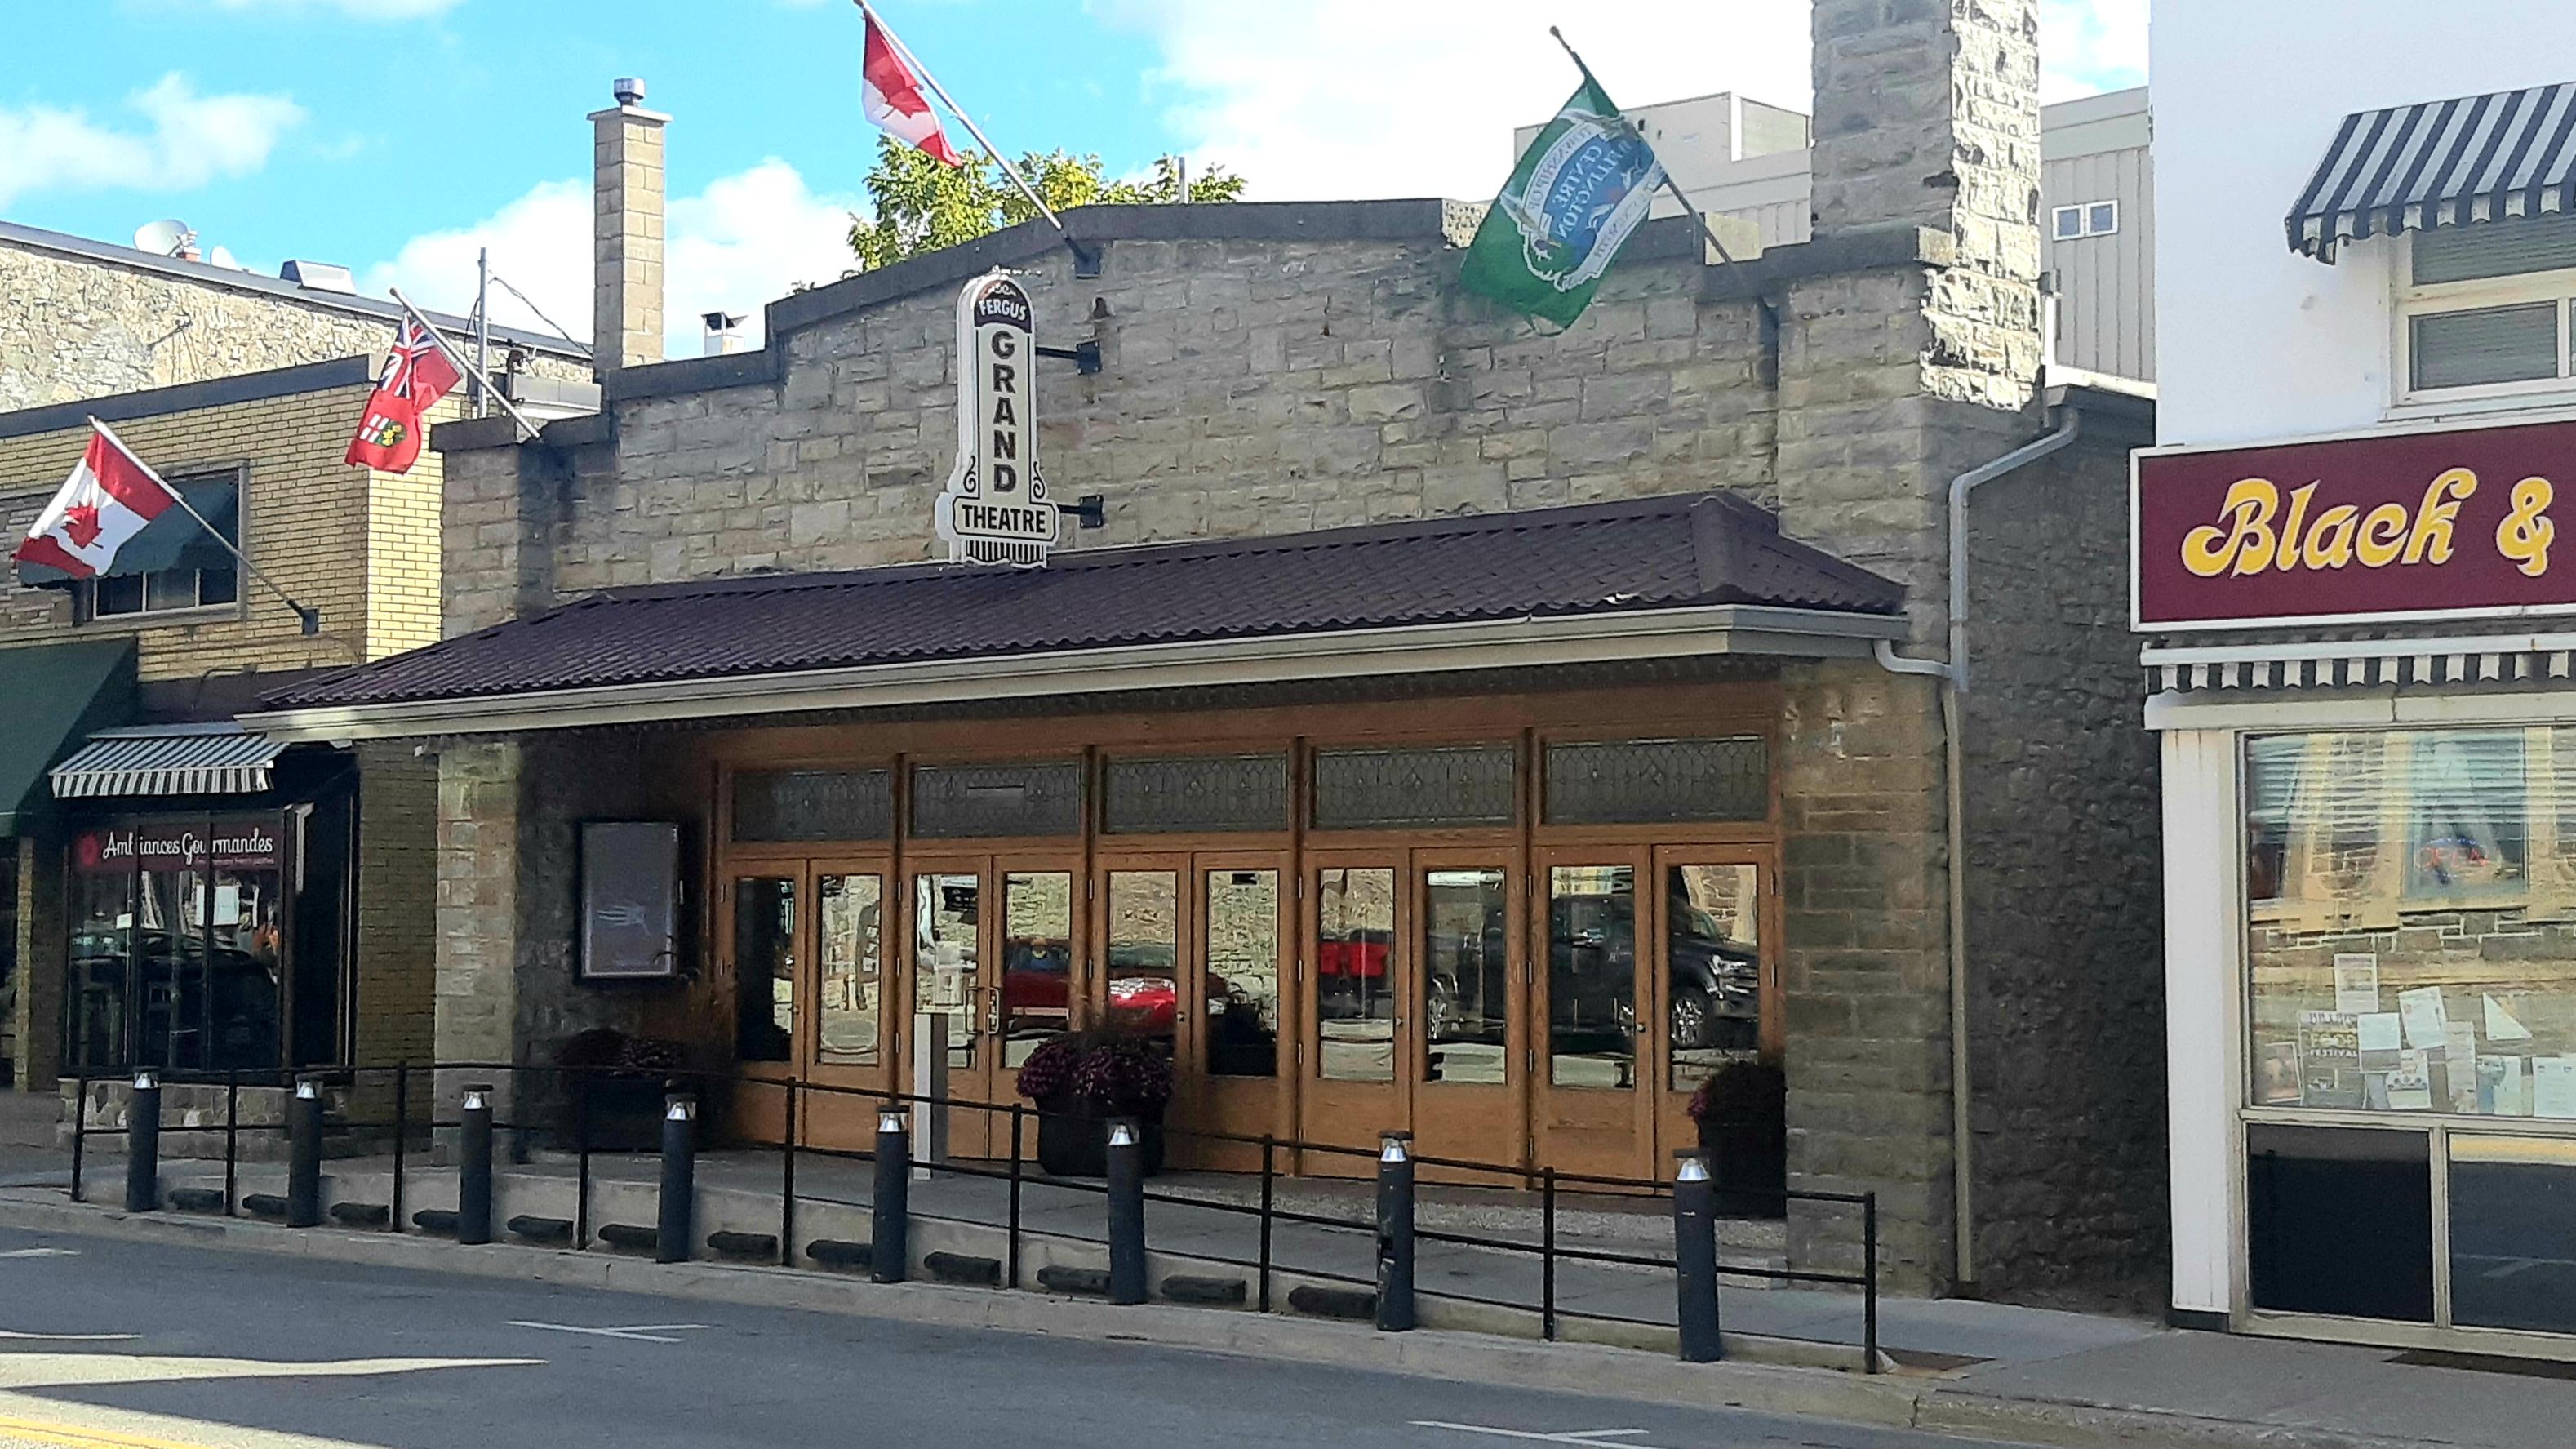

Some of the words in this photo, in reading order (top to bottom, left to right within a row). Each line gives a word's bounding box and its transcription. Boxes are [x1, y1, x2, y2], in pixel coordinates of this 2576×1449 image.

[980, 299, 1026, 321] FERGUS
[991, 331, 1017, 492] GRAND
[962, 504, 1046, 533] THEATRE
[2181, 468, 2477, 579] Black
[2496, 477, 2555, 576] &
